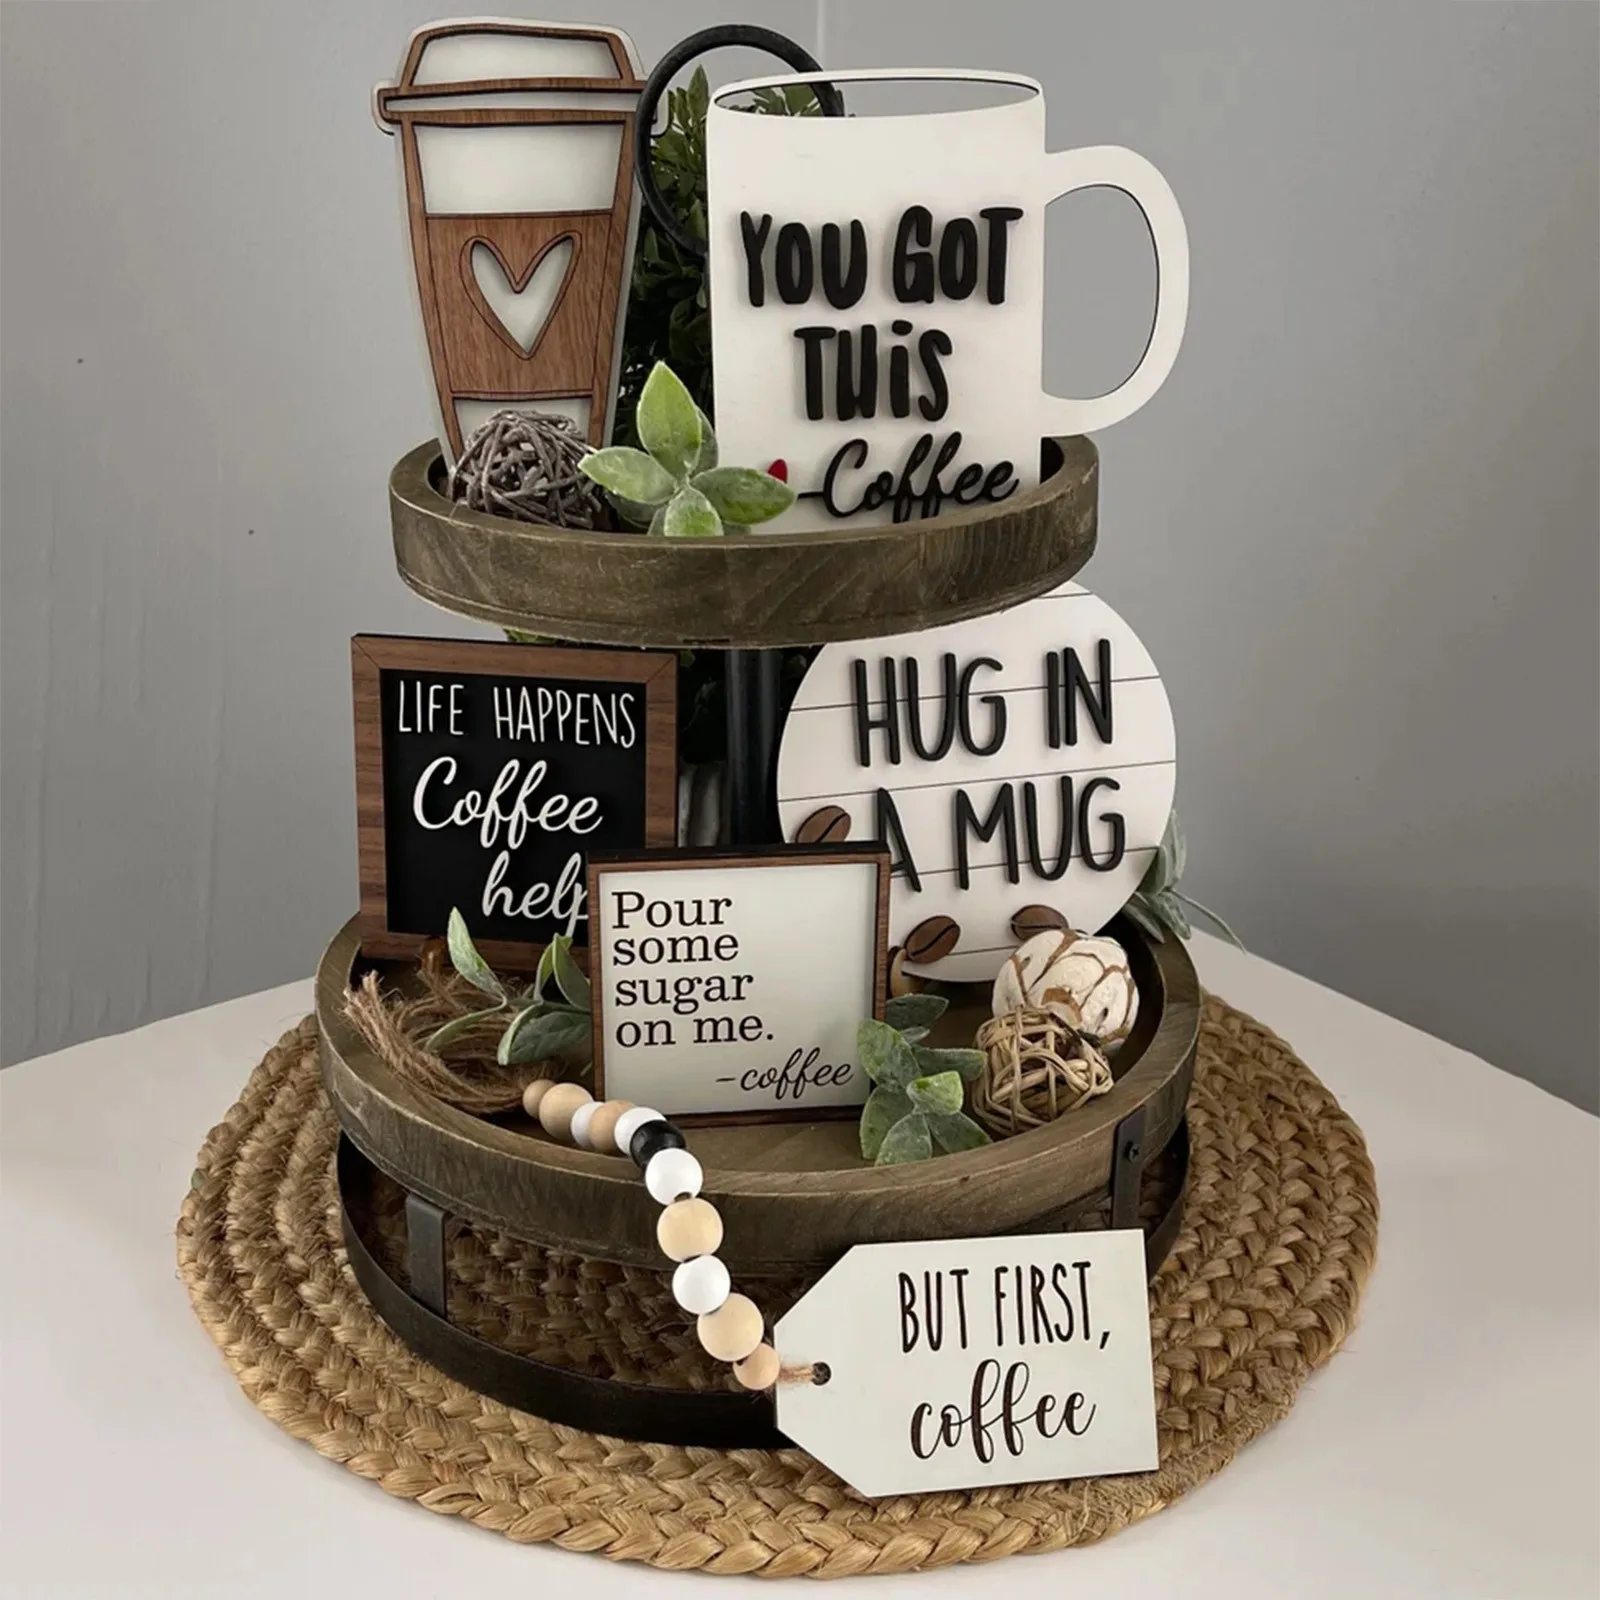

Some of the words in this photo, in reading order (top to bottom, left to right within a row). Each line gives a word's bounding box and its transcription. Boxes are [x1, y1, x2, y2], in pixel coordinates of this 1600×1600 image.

[740, 210, 868, 310] YOU
[892, 205, 1024, 305] GOT
[399, 680, 465, 735] LIFE
[493, 685, 637, 749] HAPPENS
[854, 651, 1008, 767] HUG
[1045, 638, 1112, 750] IN
[413, 756, 604, 850] Coffee
[876, 786, 922, 893] A
[955, 774, 1126, 891] MUG
[611, 890, 733, 929] Pour
[612, 932, 740, 966] some
[614, 973, 754, 1015] sugar
[615, 1017, 676, 1048] on
[692, 1013, 774, 1044] me.
[898, 1268, 969, 1353] BUT
[993, 1260, 1111, 1350] FIRST,
[910, 1358, 1097, 1464] coffee
